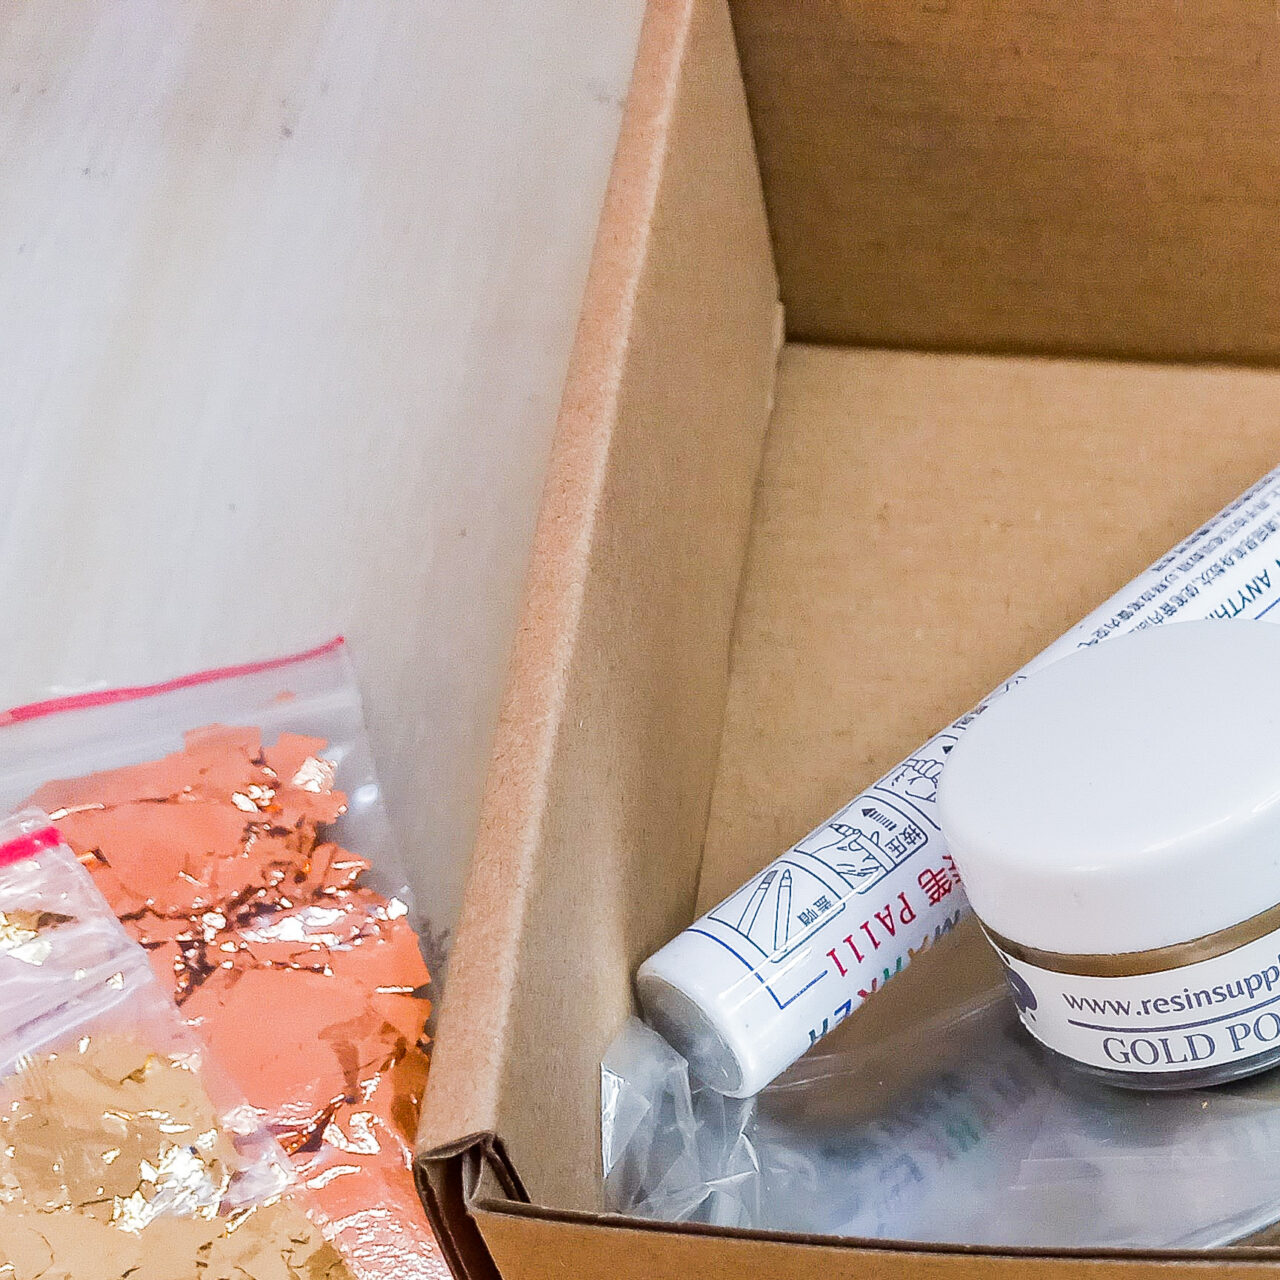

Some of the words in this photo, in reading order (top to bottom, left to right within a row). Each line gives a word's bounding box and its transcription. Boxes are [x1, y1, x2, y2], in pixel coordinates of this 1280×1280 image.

[1205, 568, 1272, 621] ANYTH
[885, 822, 924, 860] 按压
[1103, 1033, 1216, 1065] GOLD
